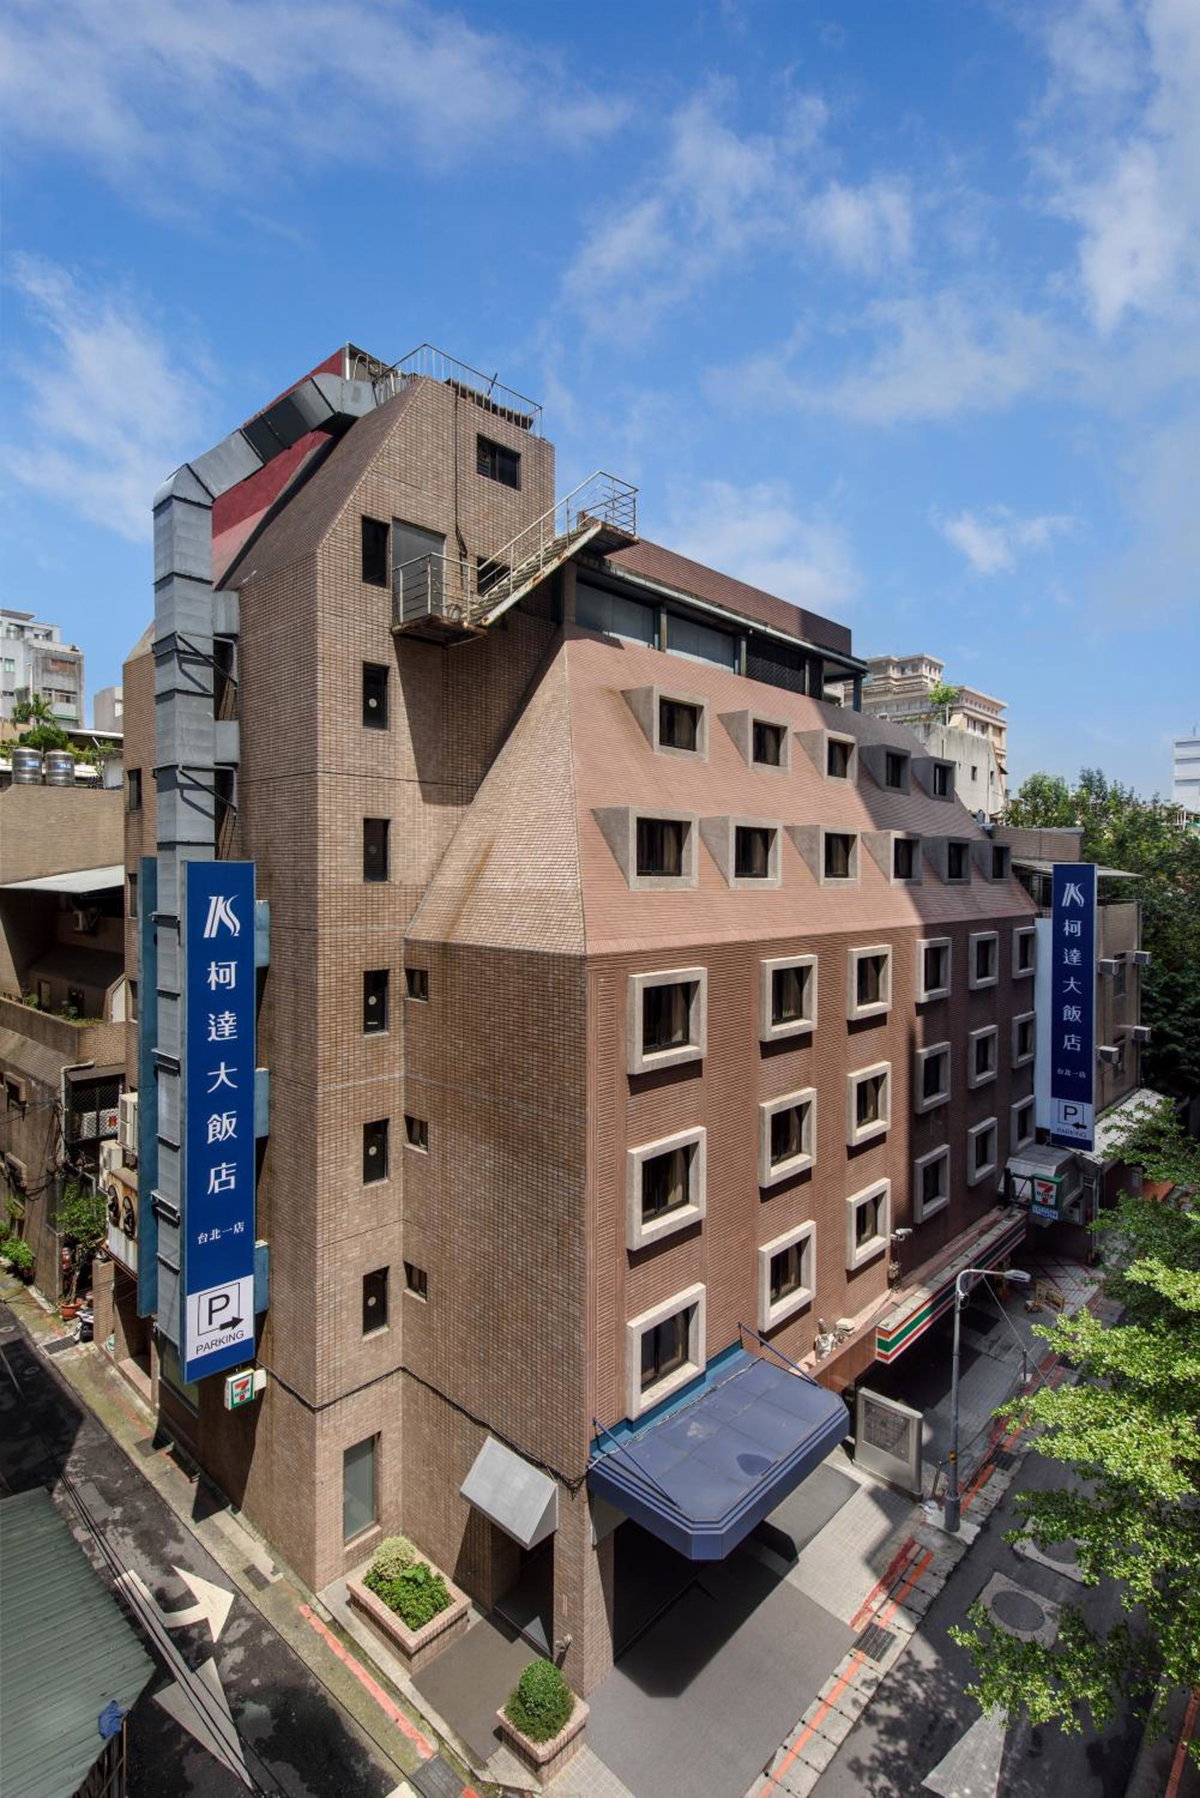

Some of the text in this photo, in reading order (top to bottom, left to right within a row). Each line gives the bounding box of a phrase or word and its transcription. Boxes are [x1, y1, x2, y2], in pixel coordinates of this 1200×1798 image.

[1062, 919, 1083, 1051] 柯達大飯店
[206, 961, 239, 1195] 柯達大飯店
[1064, 1105, 1078, 1120] P
[197, 1221, 245, 1245] 台北一店
[208, 1293, 230, 1326] P
[195, 1329, 245, 1355] PARKING
